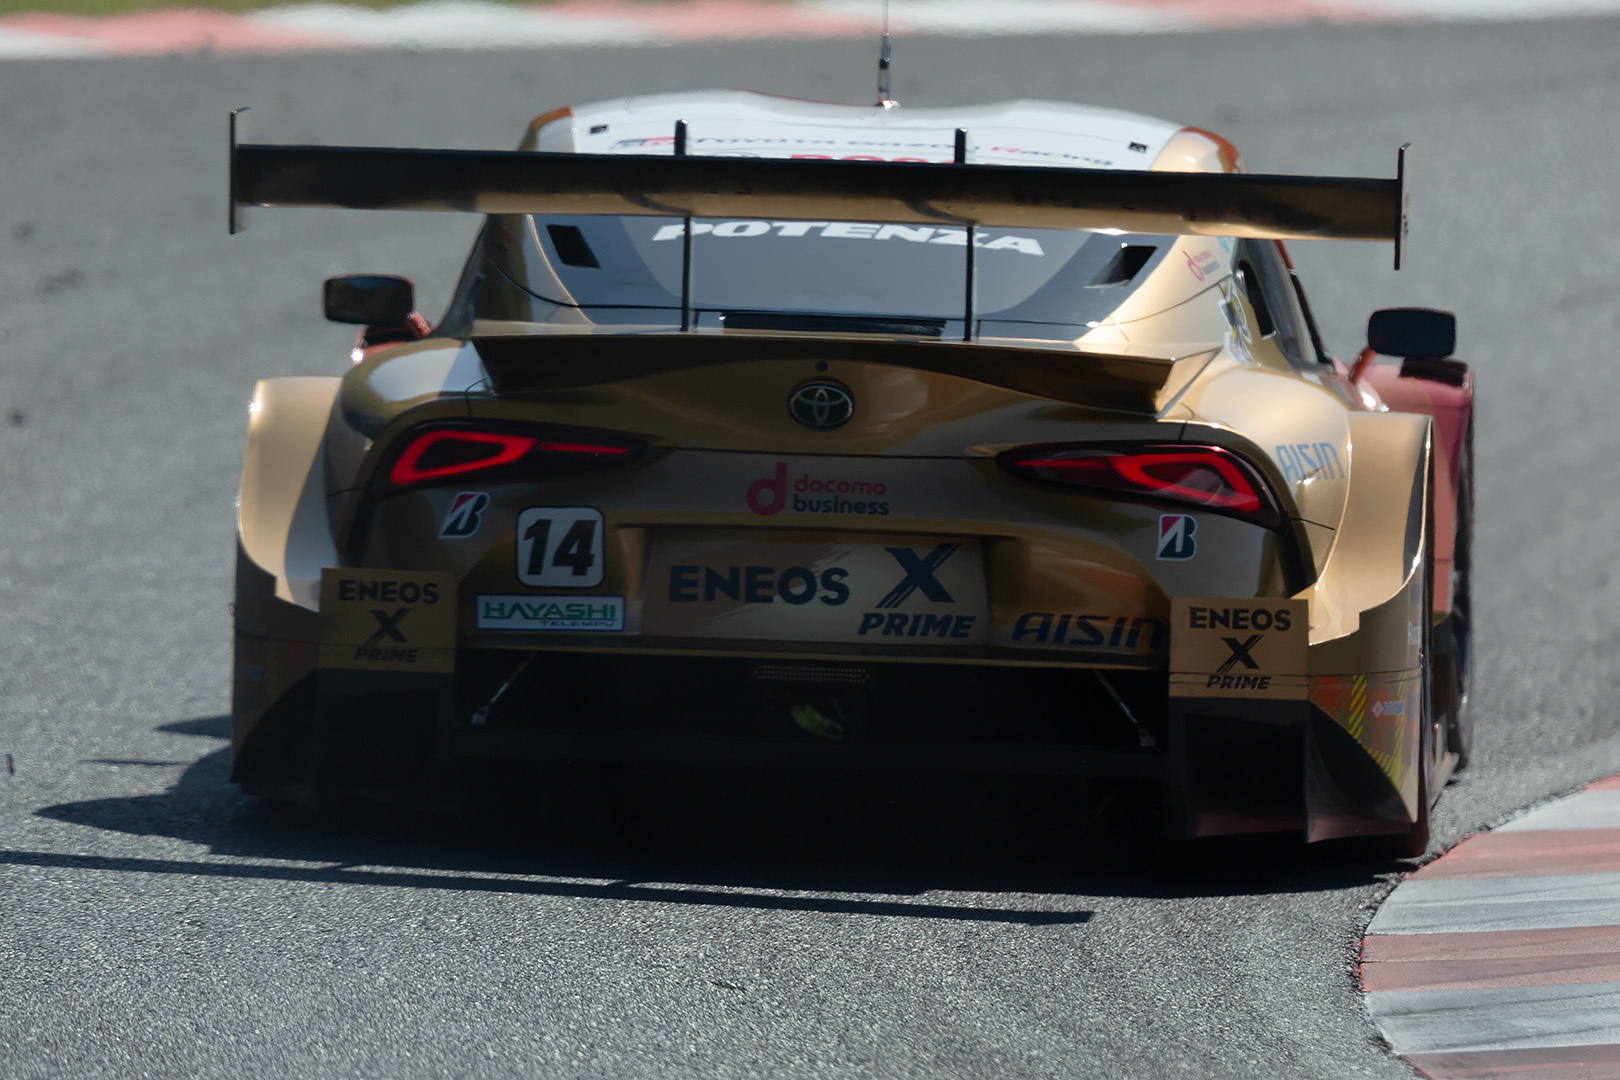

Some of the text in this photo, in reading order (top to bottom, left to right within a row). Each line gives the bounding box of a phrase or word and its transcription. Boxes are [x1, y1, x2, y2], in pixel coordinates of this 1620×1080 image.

[652, 220, 1045, 257] POTENZA
[794, 474, 887, 496] docomo
[793, 494, 890, 516] business
[523, 518, 598, 576] 14
[669, 542, 962, 609] ENEOS X
[338, 579, 440, 606] ENEOS
[482, 602, 617, 620] HAYASHI
[1189, 606, 1292, 632] ENEOS
[363, 607, 413, 648] X
[858, 612, 977, 639] PRIME
[1011, 611, 1165, 651] AISIN
[353, 647, 420, 664] PRIME
[1215, 633, 1265, 674] X
[1206, 674, 1272, 691] PRIME
